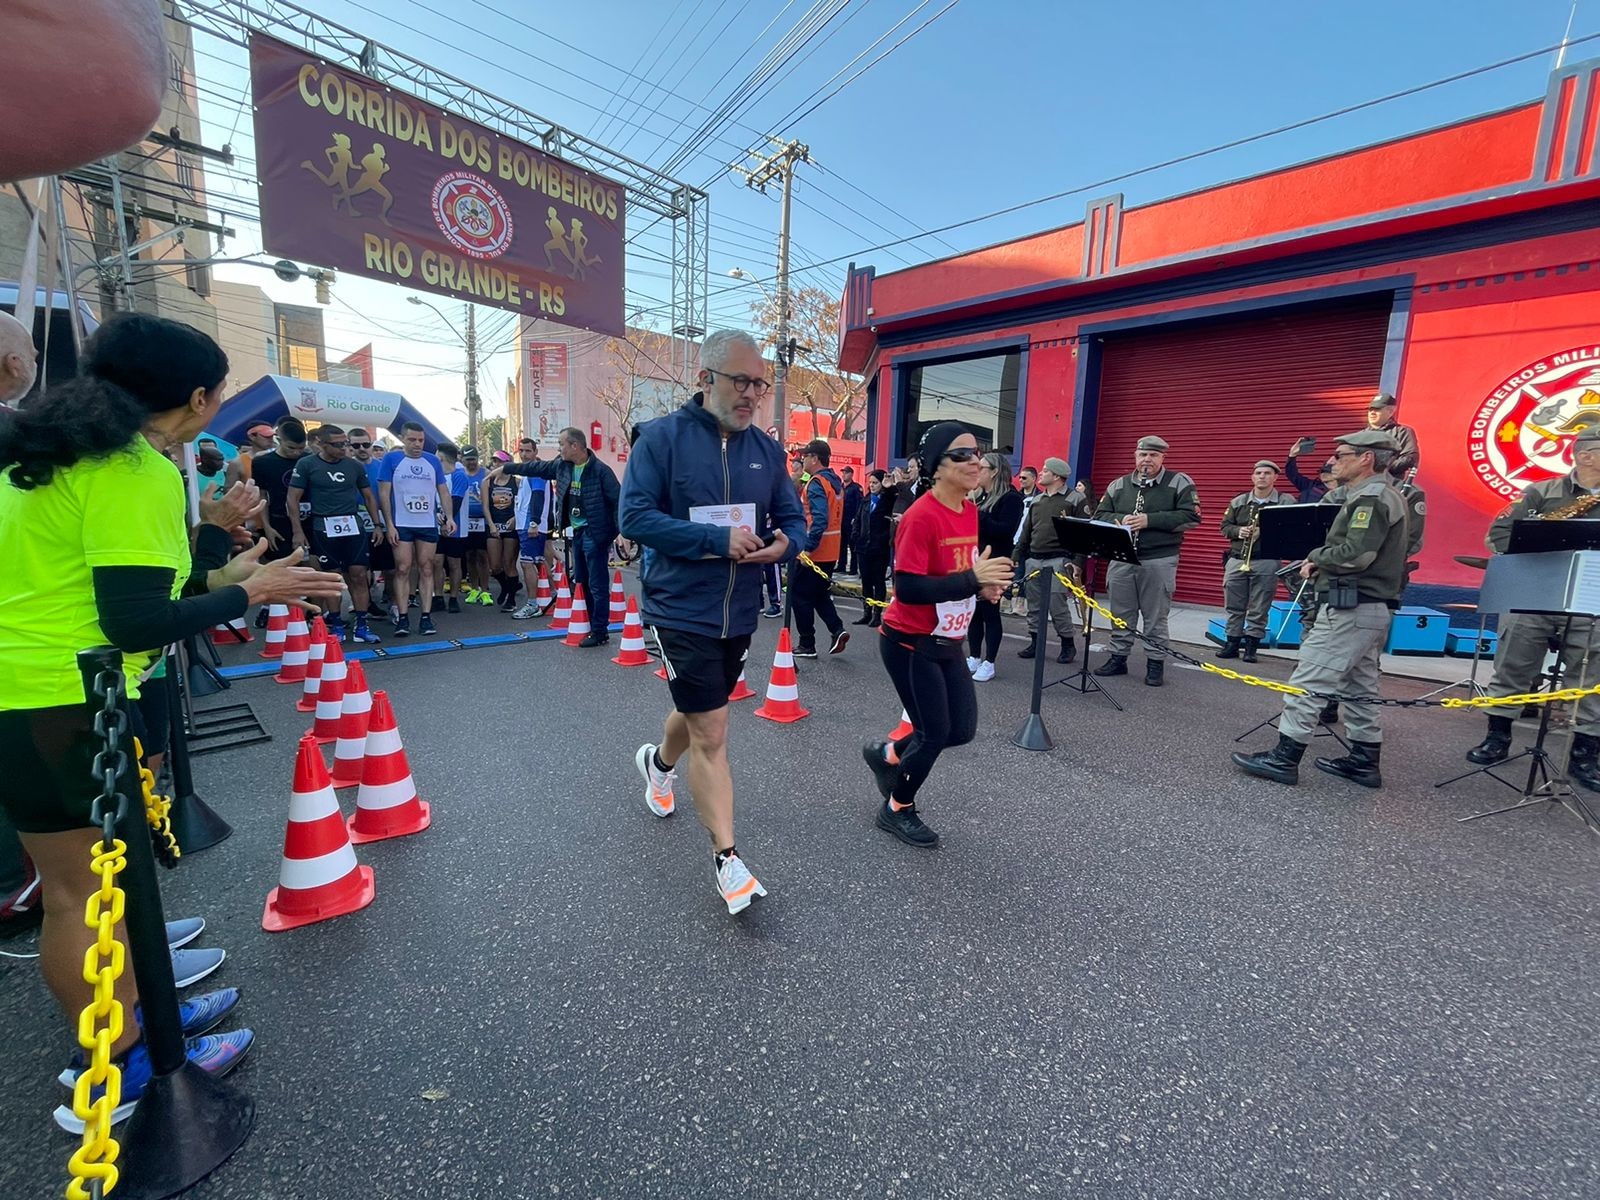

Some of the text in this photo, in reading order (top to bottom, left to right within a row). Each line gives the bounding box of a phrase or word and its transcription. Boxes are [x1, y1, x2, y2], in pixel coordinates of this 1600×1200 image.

[298, 63, 619, 221] CORRIDA DOS BOMBEIROS
[431, 173, 455, 209] BOMBEIROS
[455, 171, 486, 186] MILITAR
[363, 232, 413, 279] RIO
[420, 250, 520, 305] GRANDE
[539, 281, 566, 317] RS
[1552, 346, 1600, 366] MILI
[327, 399, 347, 409] Rio
[350, 401, 391, 413] Grande
[1471, 362, 1548, 439] BOMBEIROS
[1471, 442, 1484, 461] DE
[406, 501, 429, 511] 105
[333, 524, 352, 534] 94
[1416, 616, 1428, 629] 3
[1480, 638, 1491, 653] 5
